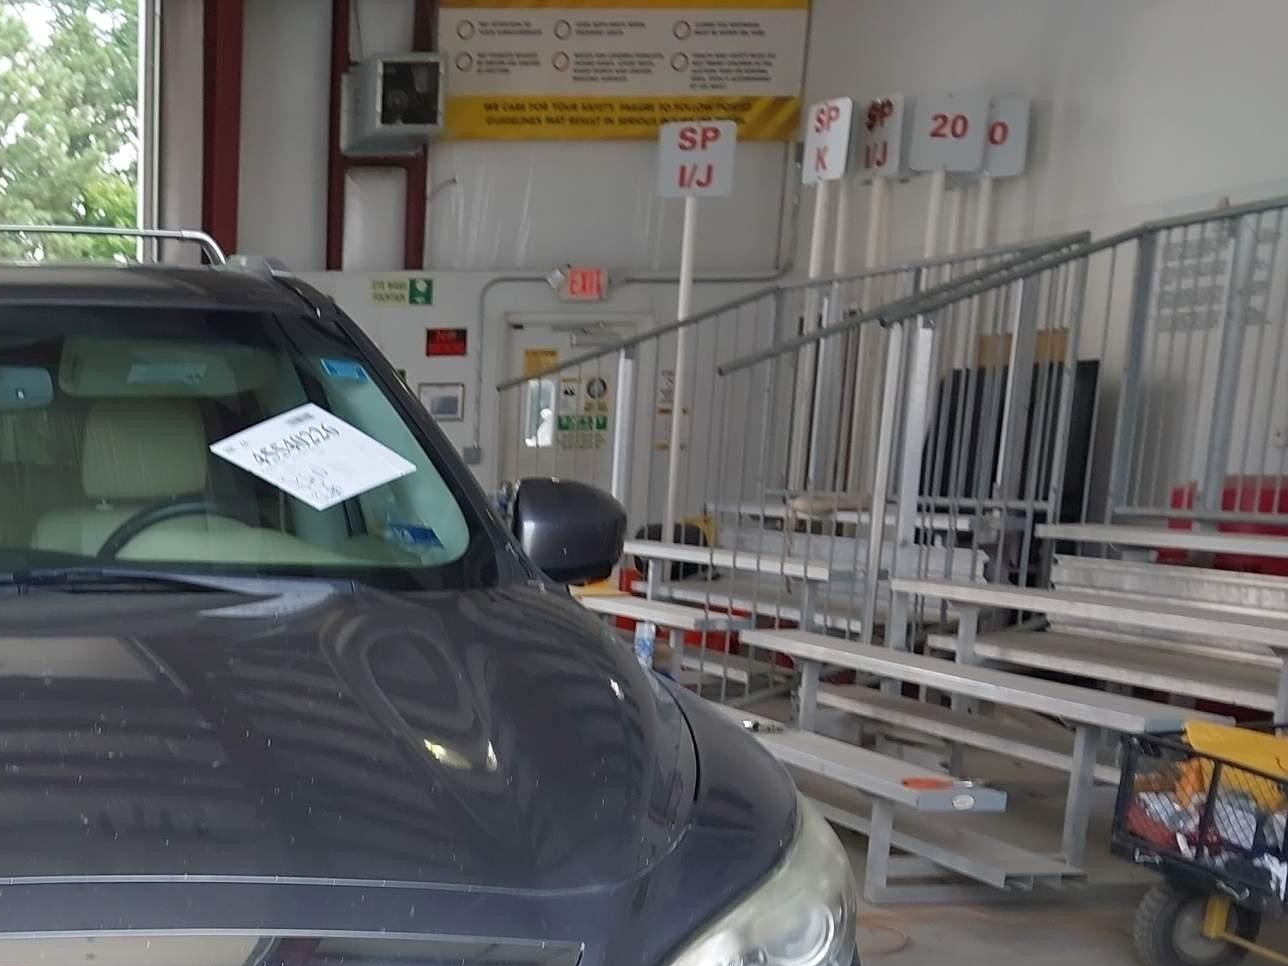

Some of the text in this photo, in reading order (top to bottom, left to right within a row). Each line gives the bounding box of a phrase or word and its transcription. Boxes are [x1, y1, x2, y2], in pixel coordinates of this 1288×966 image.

[814, 105, 840, 133] SP
[929, 113, 969, 138] 20
[678, 127, 721, 151] SP
[815, 145, 828, 171] K
[679, 163, 714, 188] I/J
[570, 270, 601, 297] EXIT
